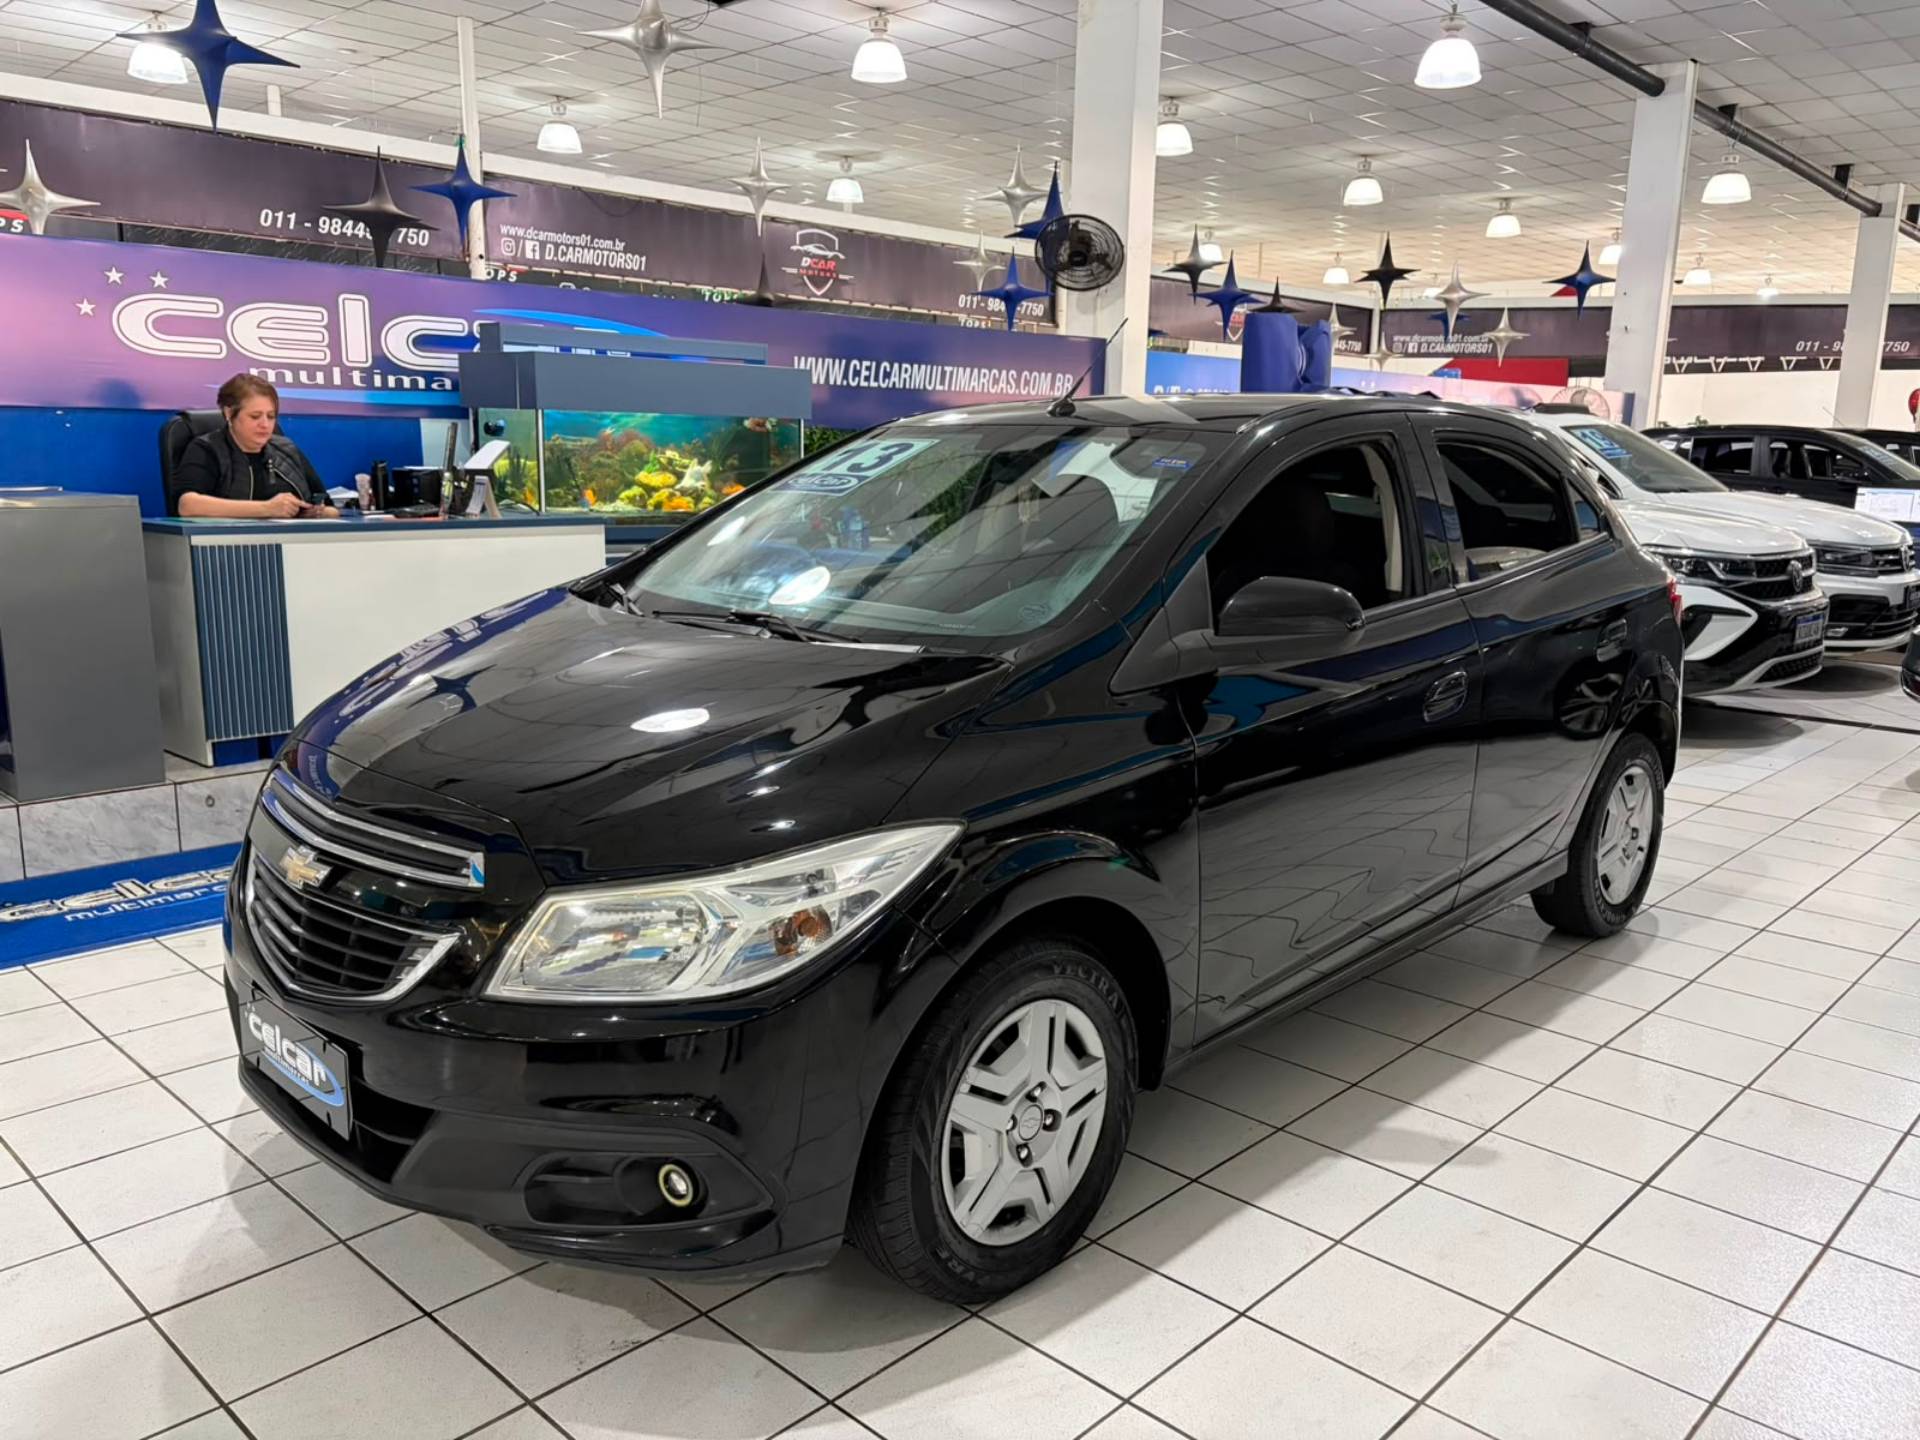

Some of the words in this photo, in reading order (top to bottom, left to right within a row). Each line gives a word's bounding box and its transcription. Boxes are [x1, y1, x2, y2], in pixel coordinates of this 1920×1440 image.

[260, 209, 297, 230] 011
[500, 224, 626, 251] www.dcarmotors01.com.br
[545, 244, 647, 271] D.CARMOTORS01
[801, 257, 837, 271] DCAR
[959, 294, 979, 309] 011
[112, 292, 481, 373] celc
[1796, 341, 1820, 352] 011
[822, 442, 915, 473] 13
